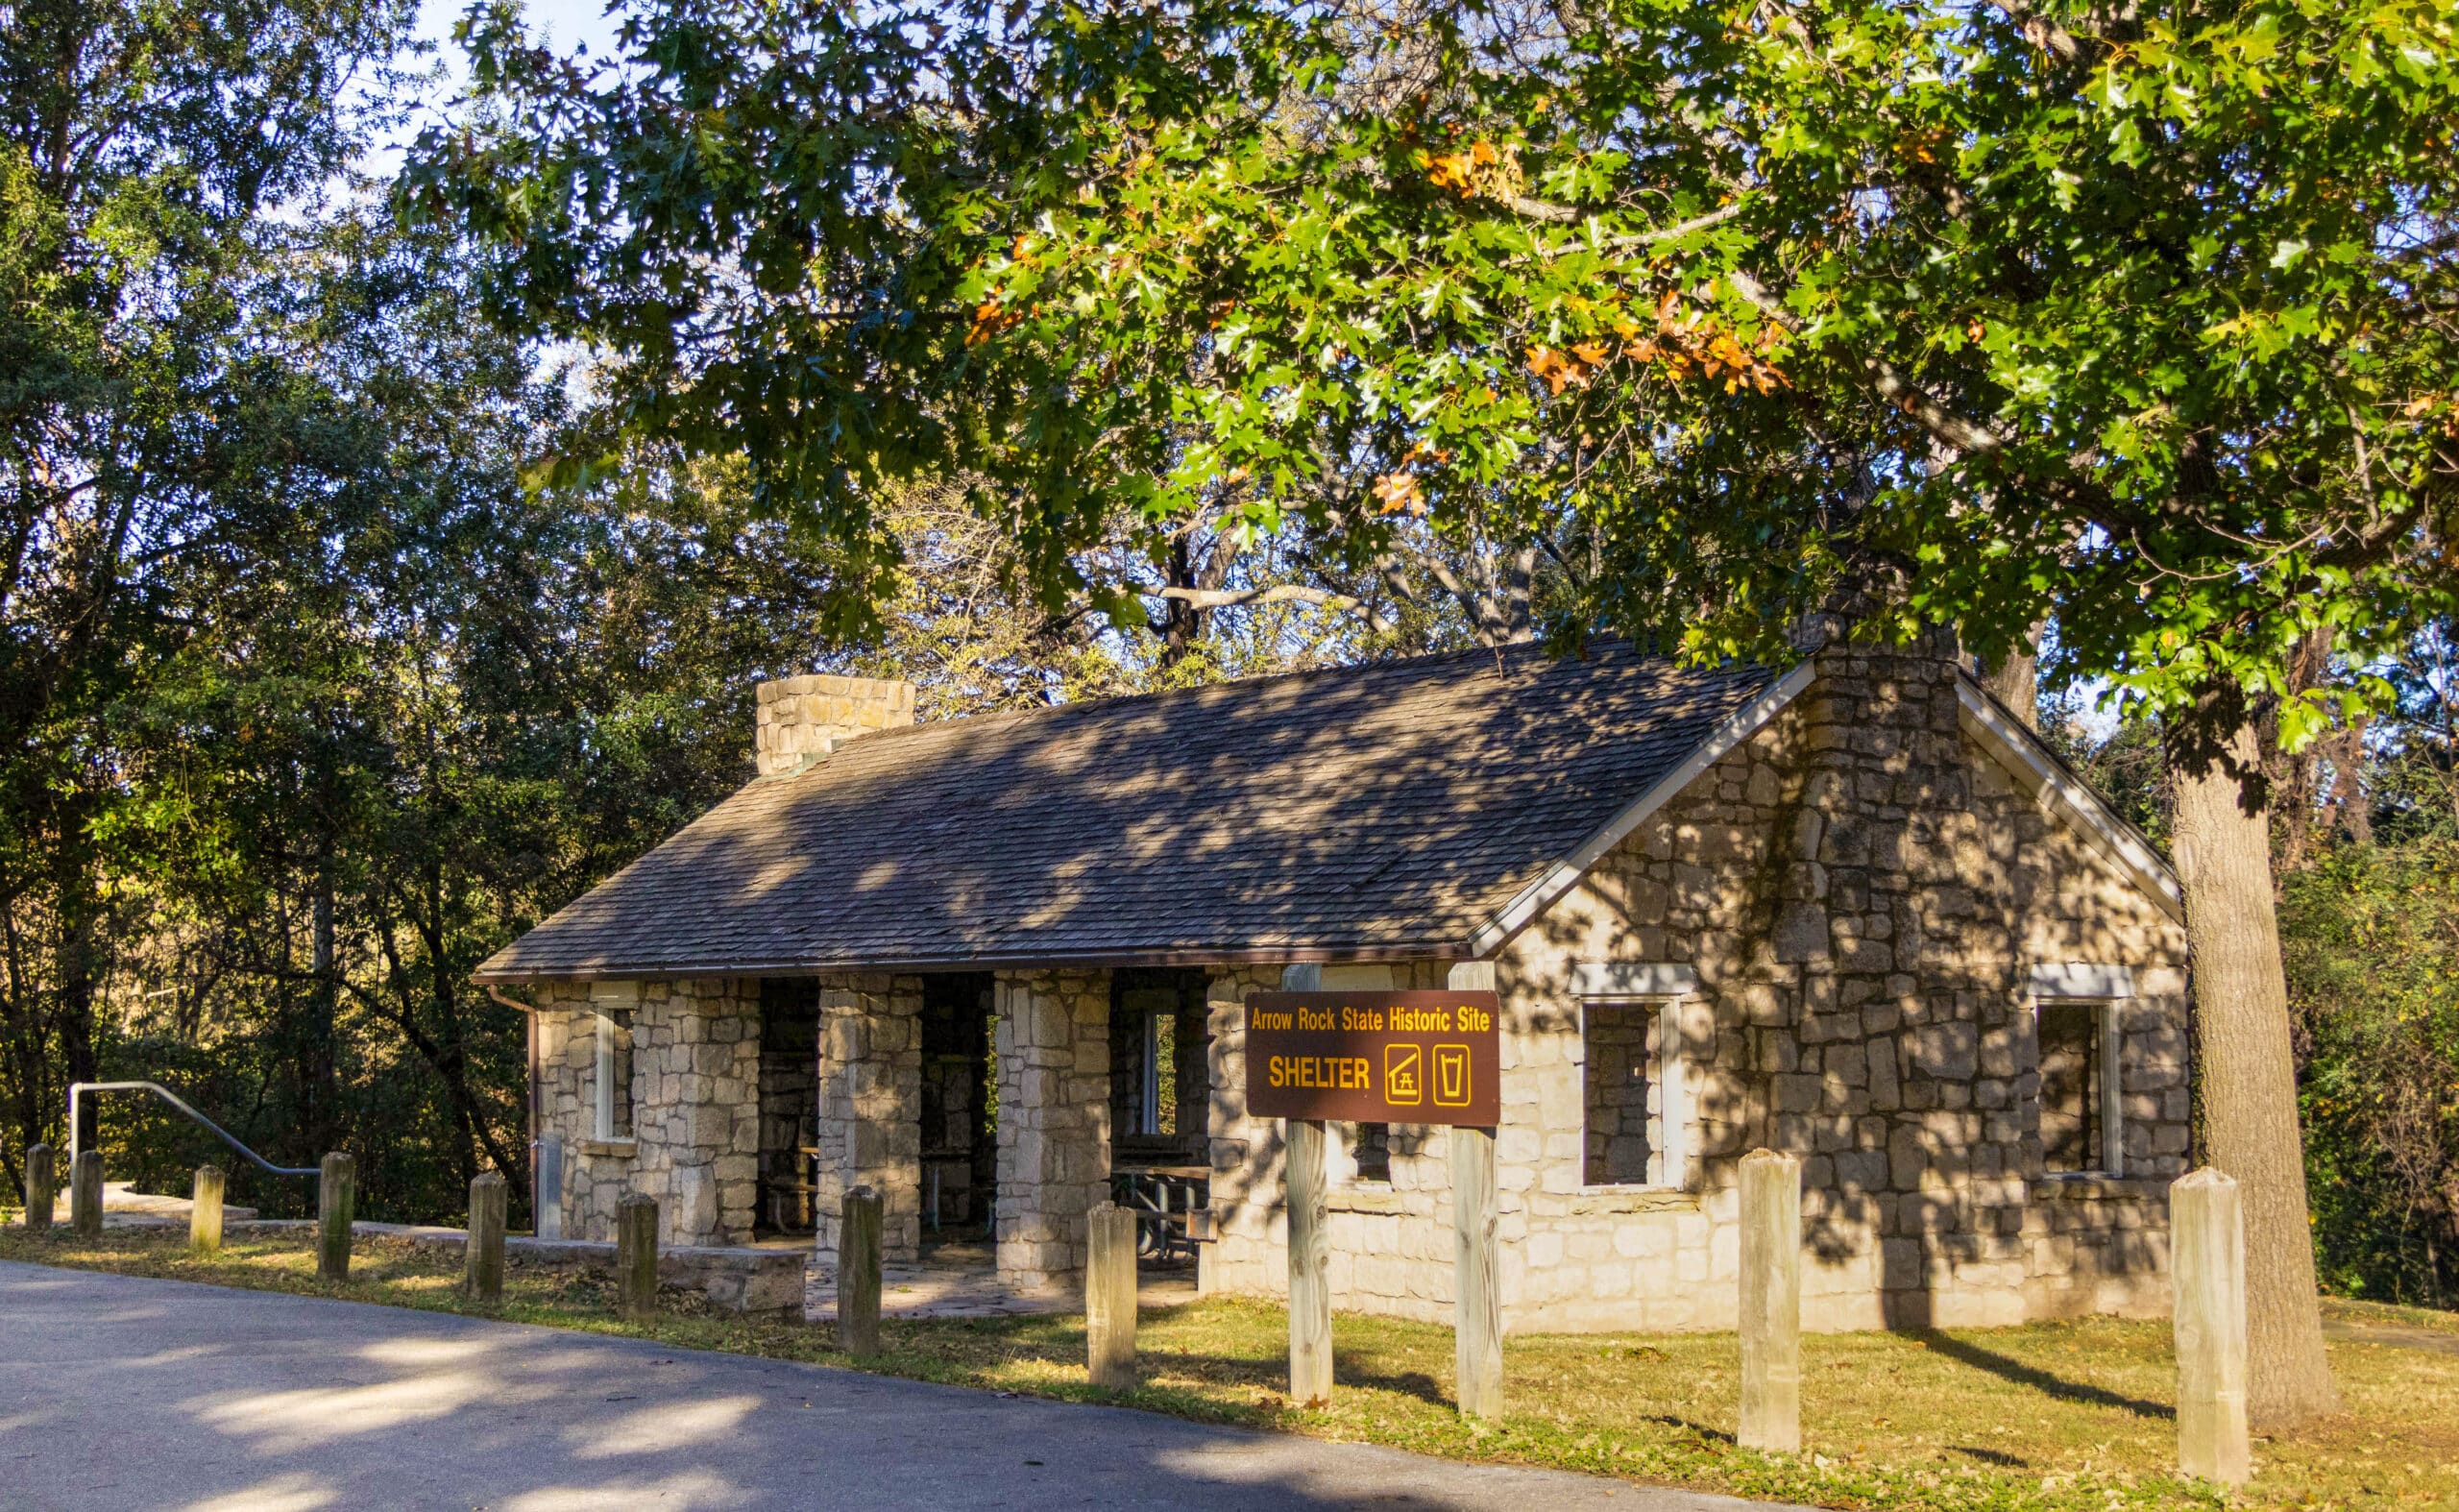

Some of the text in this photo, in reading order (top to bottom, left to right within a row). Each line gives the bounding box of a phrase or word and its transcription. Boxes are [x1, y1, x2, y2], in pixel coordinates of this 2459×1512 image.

[1252, 1006, 1491, 1032] Arrow Rock State Historic Site
[1269, 1056, 1370, 1088] SHELTER
